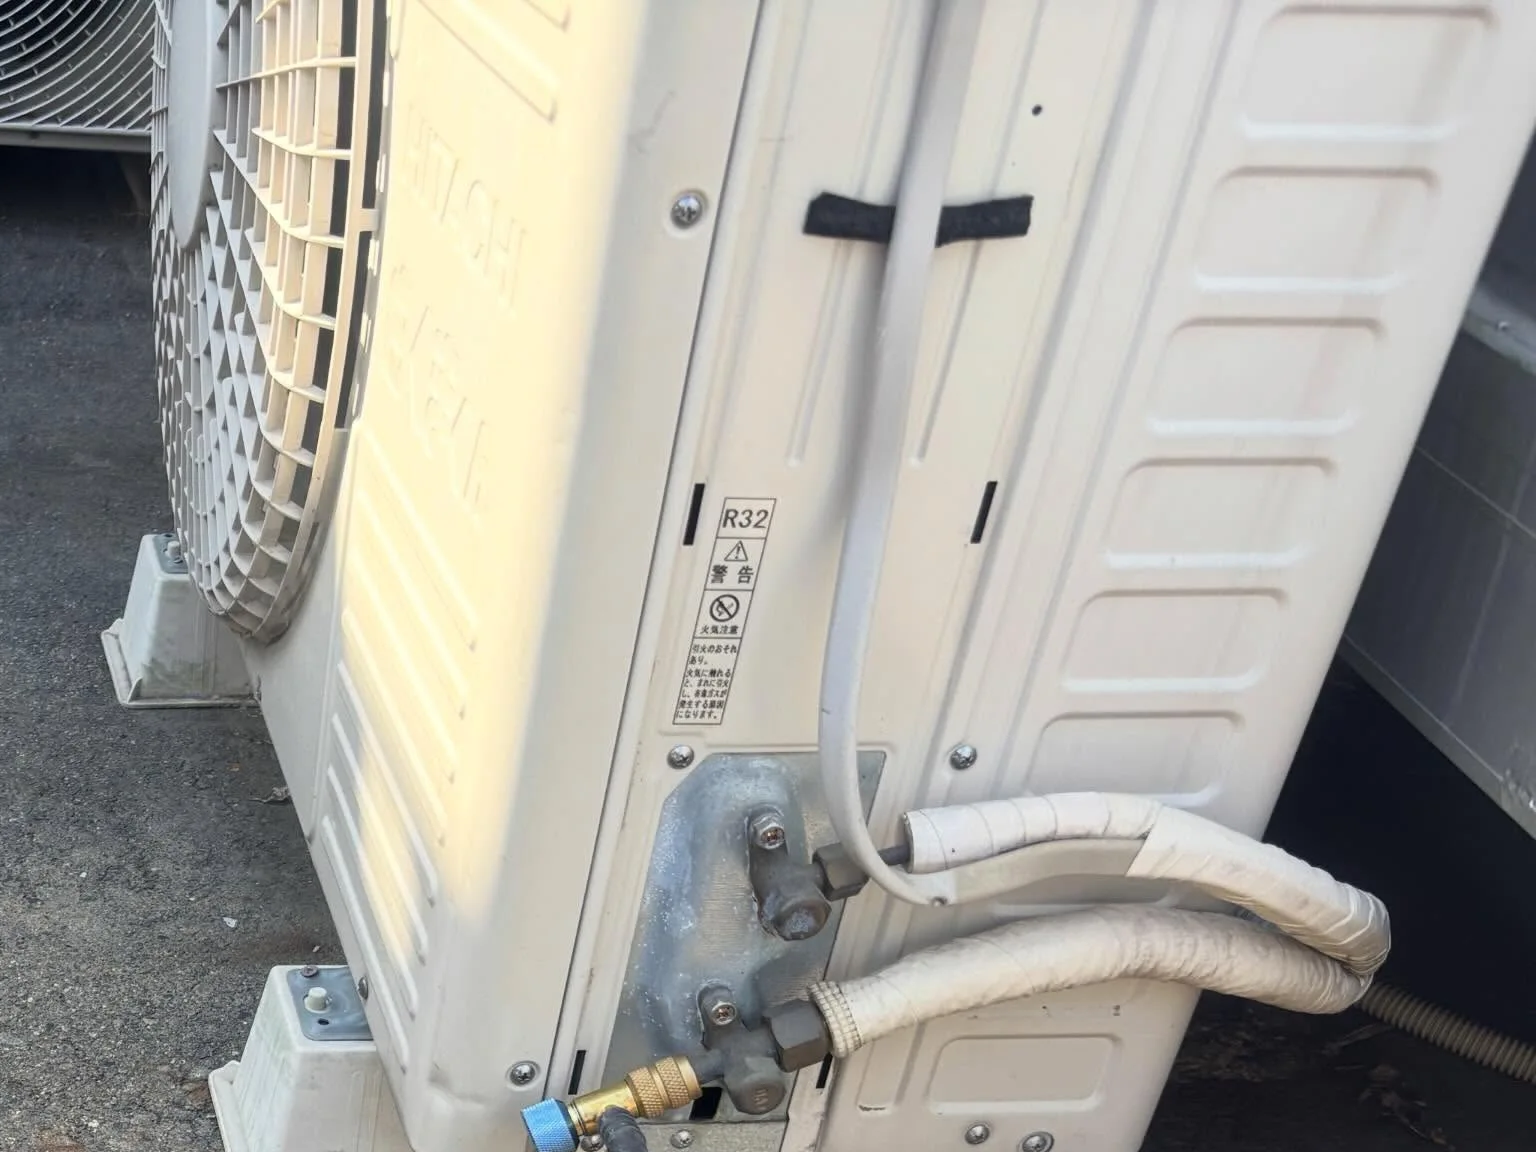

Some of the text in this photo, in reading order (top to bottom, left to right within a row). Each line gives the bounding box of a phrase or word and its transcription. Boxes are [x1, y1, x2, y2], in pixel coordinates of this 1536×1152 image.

[402, 102, 528, 312] HITACHI
[722, 508, 769, 529] R32
[700, 624, 738, 635] 火気注意
[692, 644, 737, 654] 引火のおそれ
[689, 655, 708, 665] あり。
[675, 710, 718, 719] になります。
